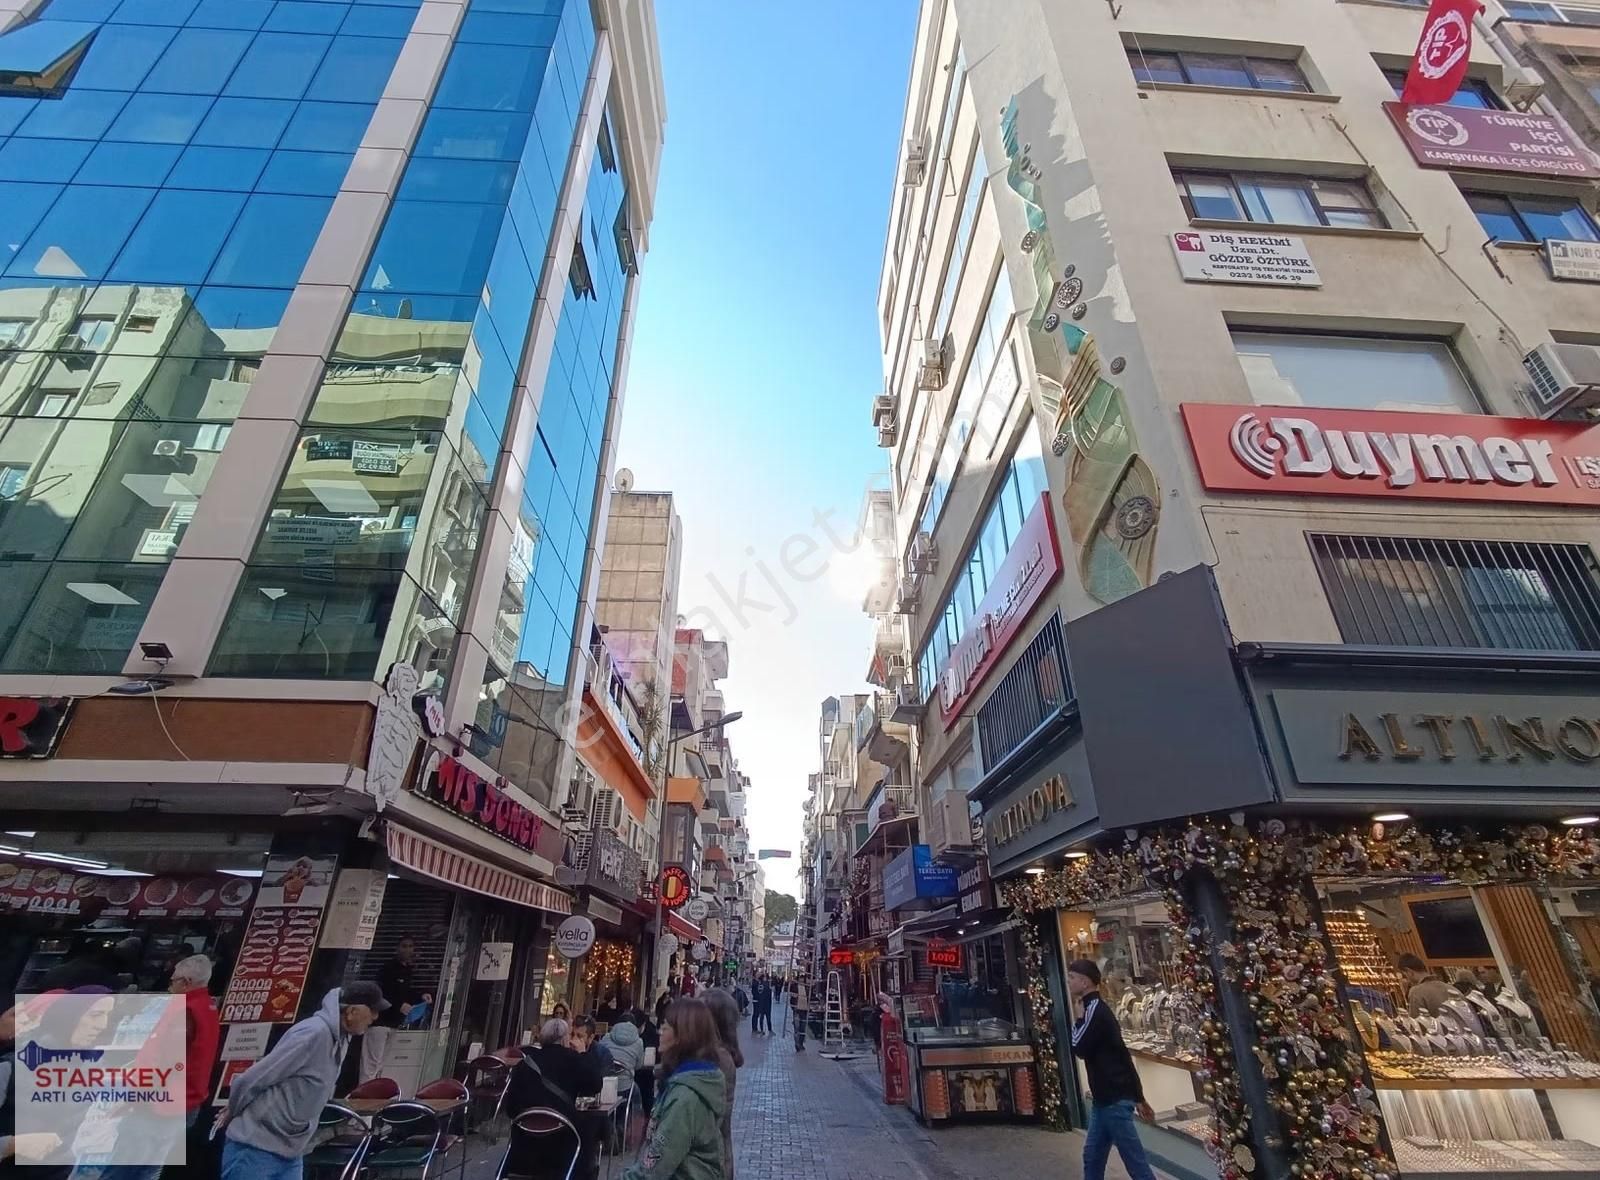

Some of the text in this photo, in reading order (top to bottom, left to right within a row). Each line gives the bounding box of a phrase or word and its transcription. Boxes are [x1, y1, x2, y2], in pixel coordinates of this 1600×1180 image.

[1420, 117, 1449, 129] TİP
[1481, 115, 1553, 130] TÜRKİYE
[1529, 129, 1563, 143] İŞÇİ
[1509, 142, 1576, 157] PARTİSİ
[1425, 151, 1585, 172] KARŞIYAKA İLÇE ÖRGÜTÜ
[1210, 234, 1292, 247] DİŞ HEKİMİ
[1231, 246, 1280, 255] Uzm.Dt.
[1209, 253, 1310, 267] GÖZDE ÖZTÜRK
[1270, 417, 1559, 489] Duymer
[992, 773, 1074, 846] ALTINOVA
[559, 928, 589, 941] vella
[932, 952, 956, 962] LOTO
